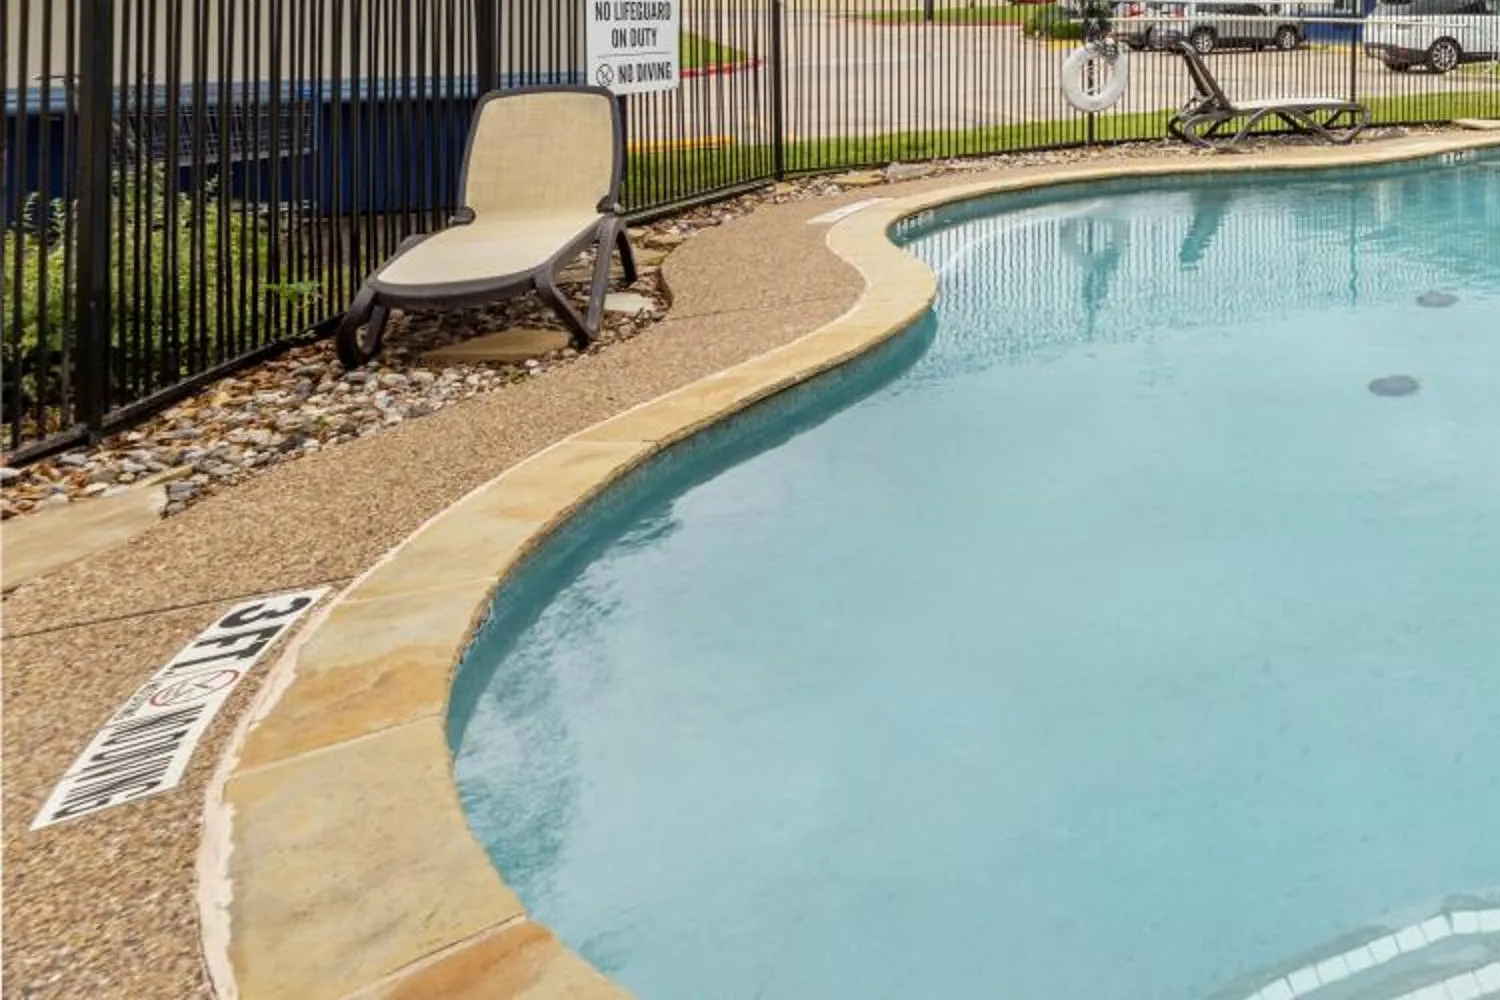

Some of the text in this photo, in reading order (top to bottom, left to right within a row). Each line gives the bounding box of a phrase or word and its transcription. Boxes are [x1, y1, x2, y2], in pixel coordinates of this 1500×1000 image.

[595, 1, 671, 21] NO LIFEGUARD
[611, 27, 657, 48] ON DUTY
[617, 61, 672, 85] NO DIVING
[171, 596, 313, 670] 3 FT
[52, 730, 189, 821] DIVING
